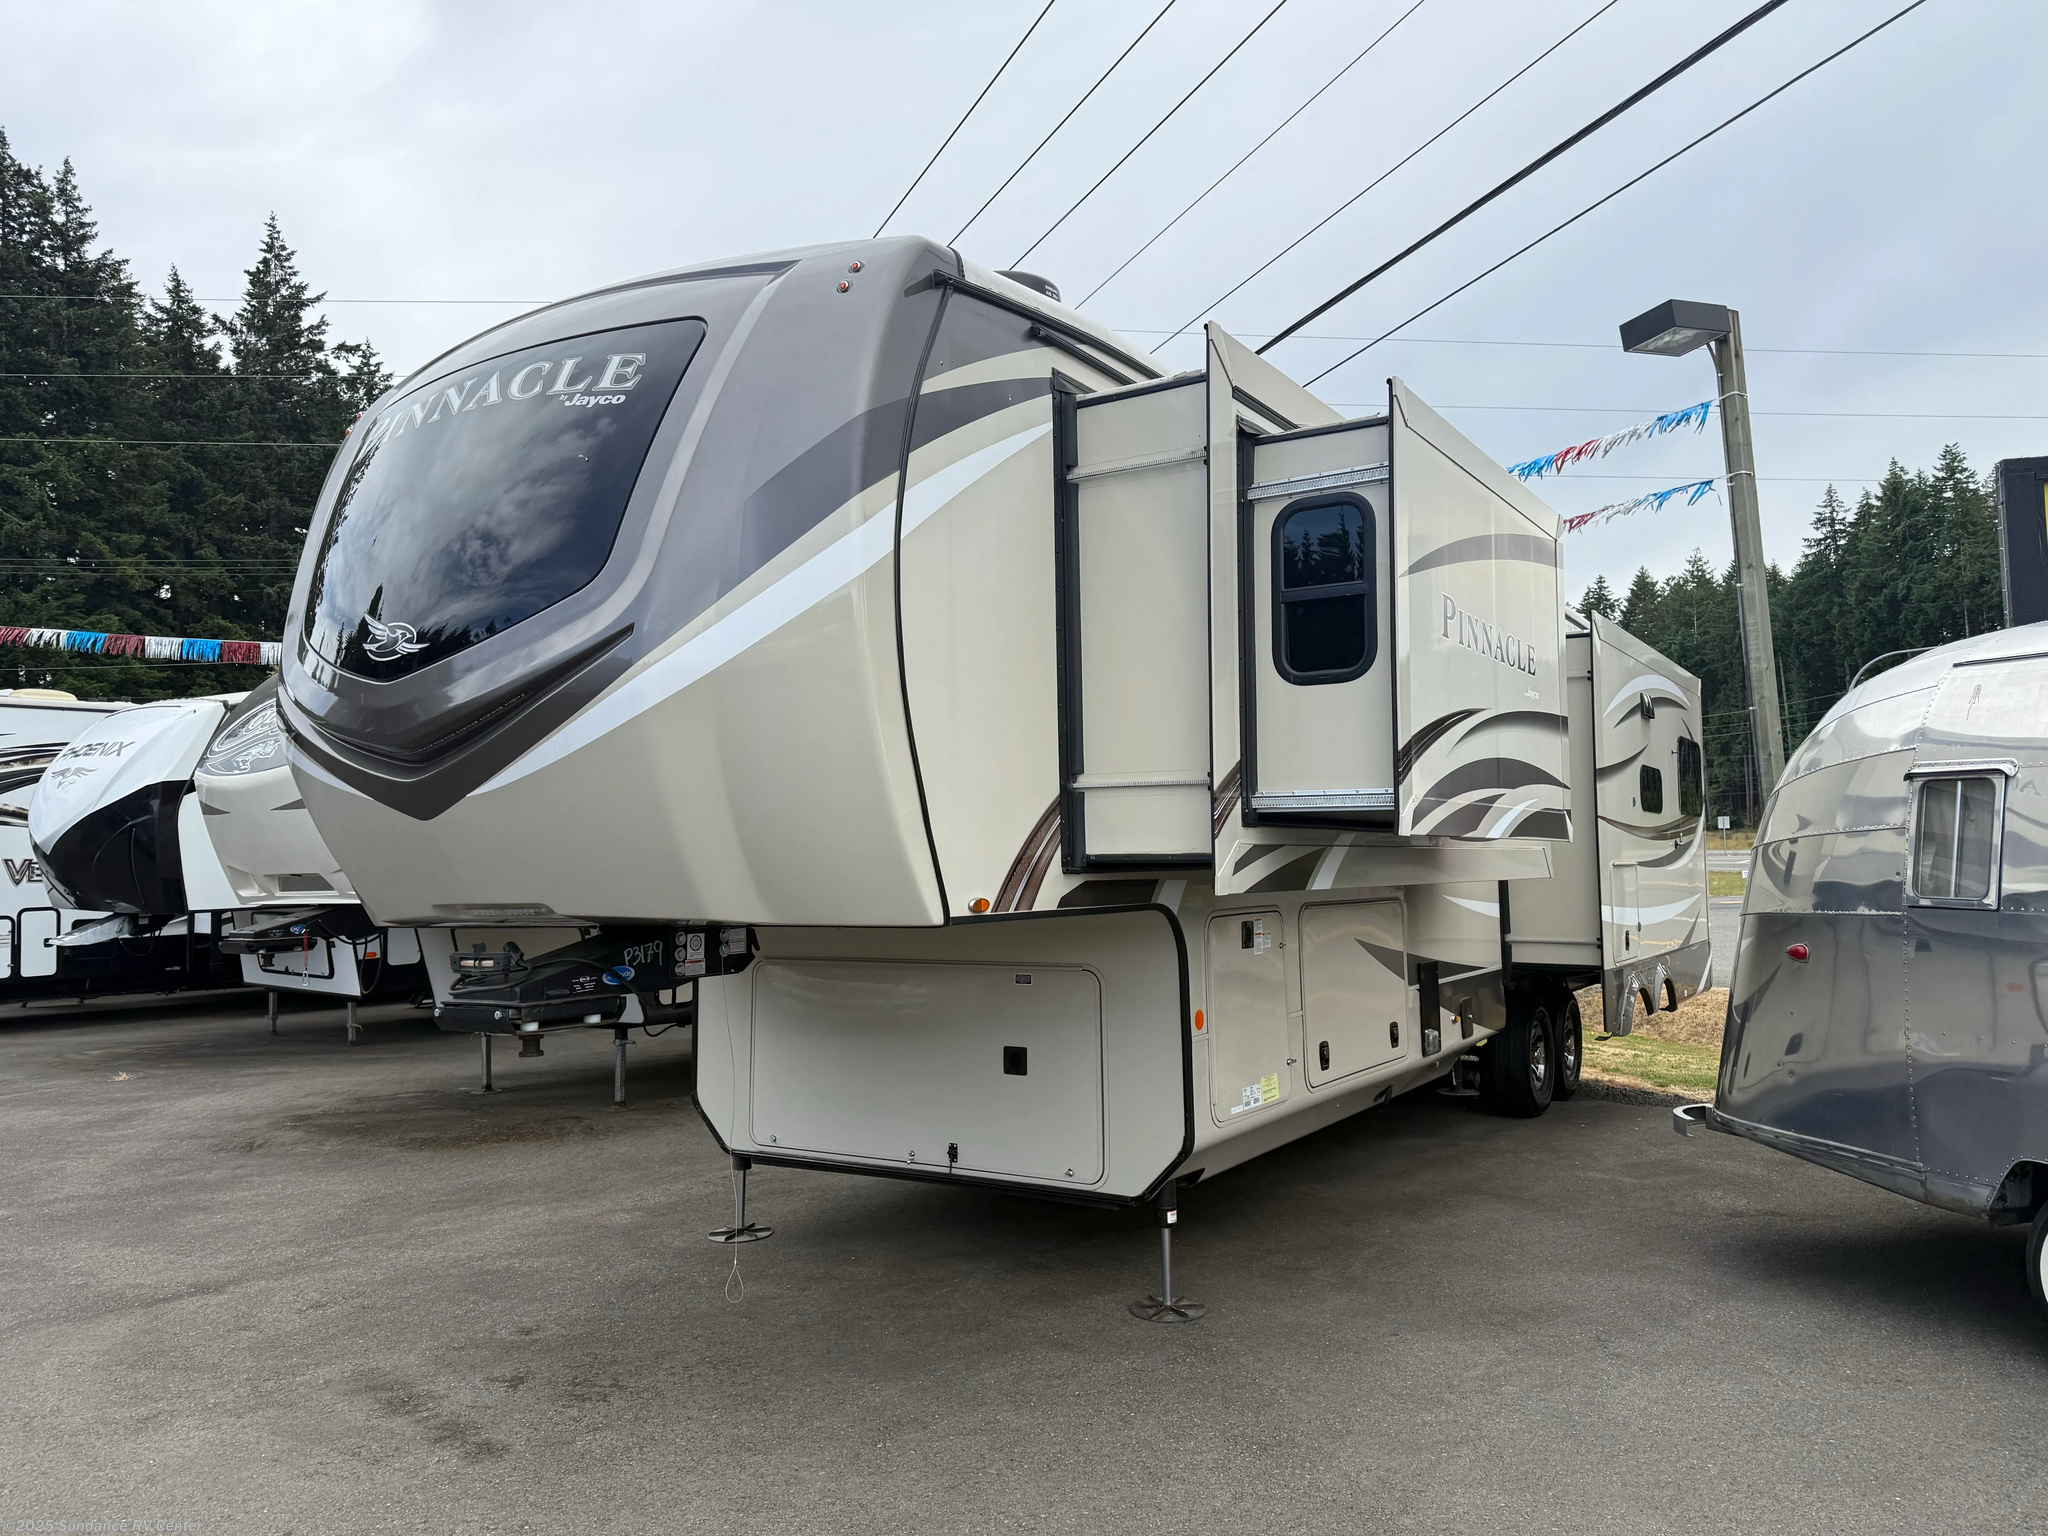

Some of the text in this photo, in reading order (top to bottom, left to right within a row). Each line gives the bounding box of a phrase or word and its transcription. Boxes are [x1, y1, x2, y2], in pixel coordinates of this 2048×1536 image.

[361, 353, 646, 445] PINNACLE
[564, 393, 626, 408] Jayco
[1441, 591, 1537, 677] PINNACLE
[624, 940, 663, 966] P3179
